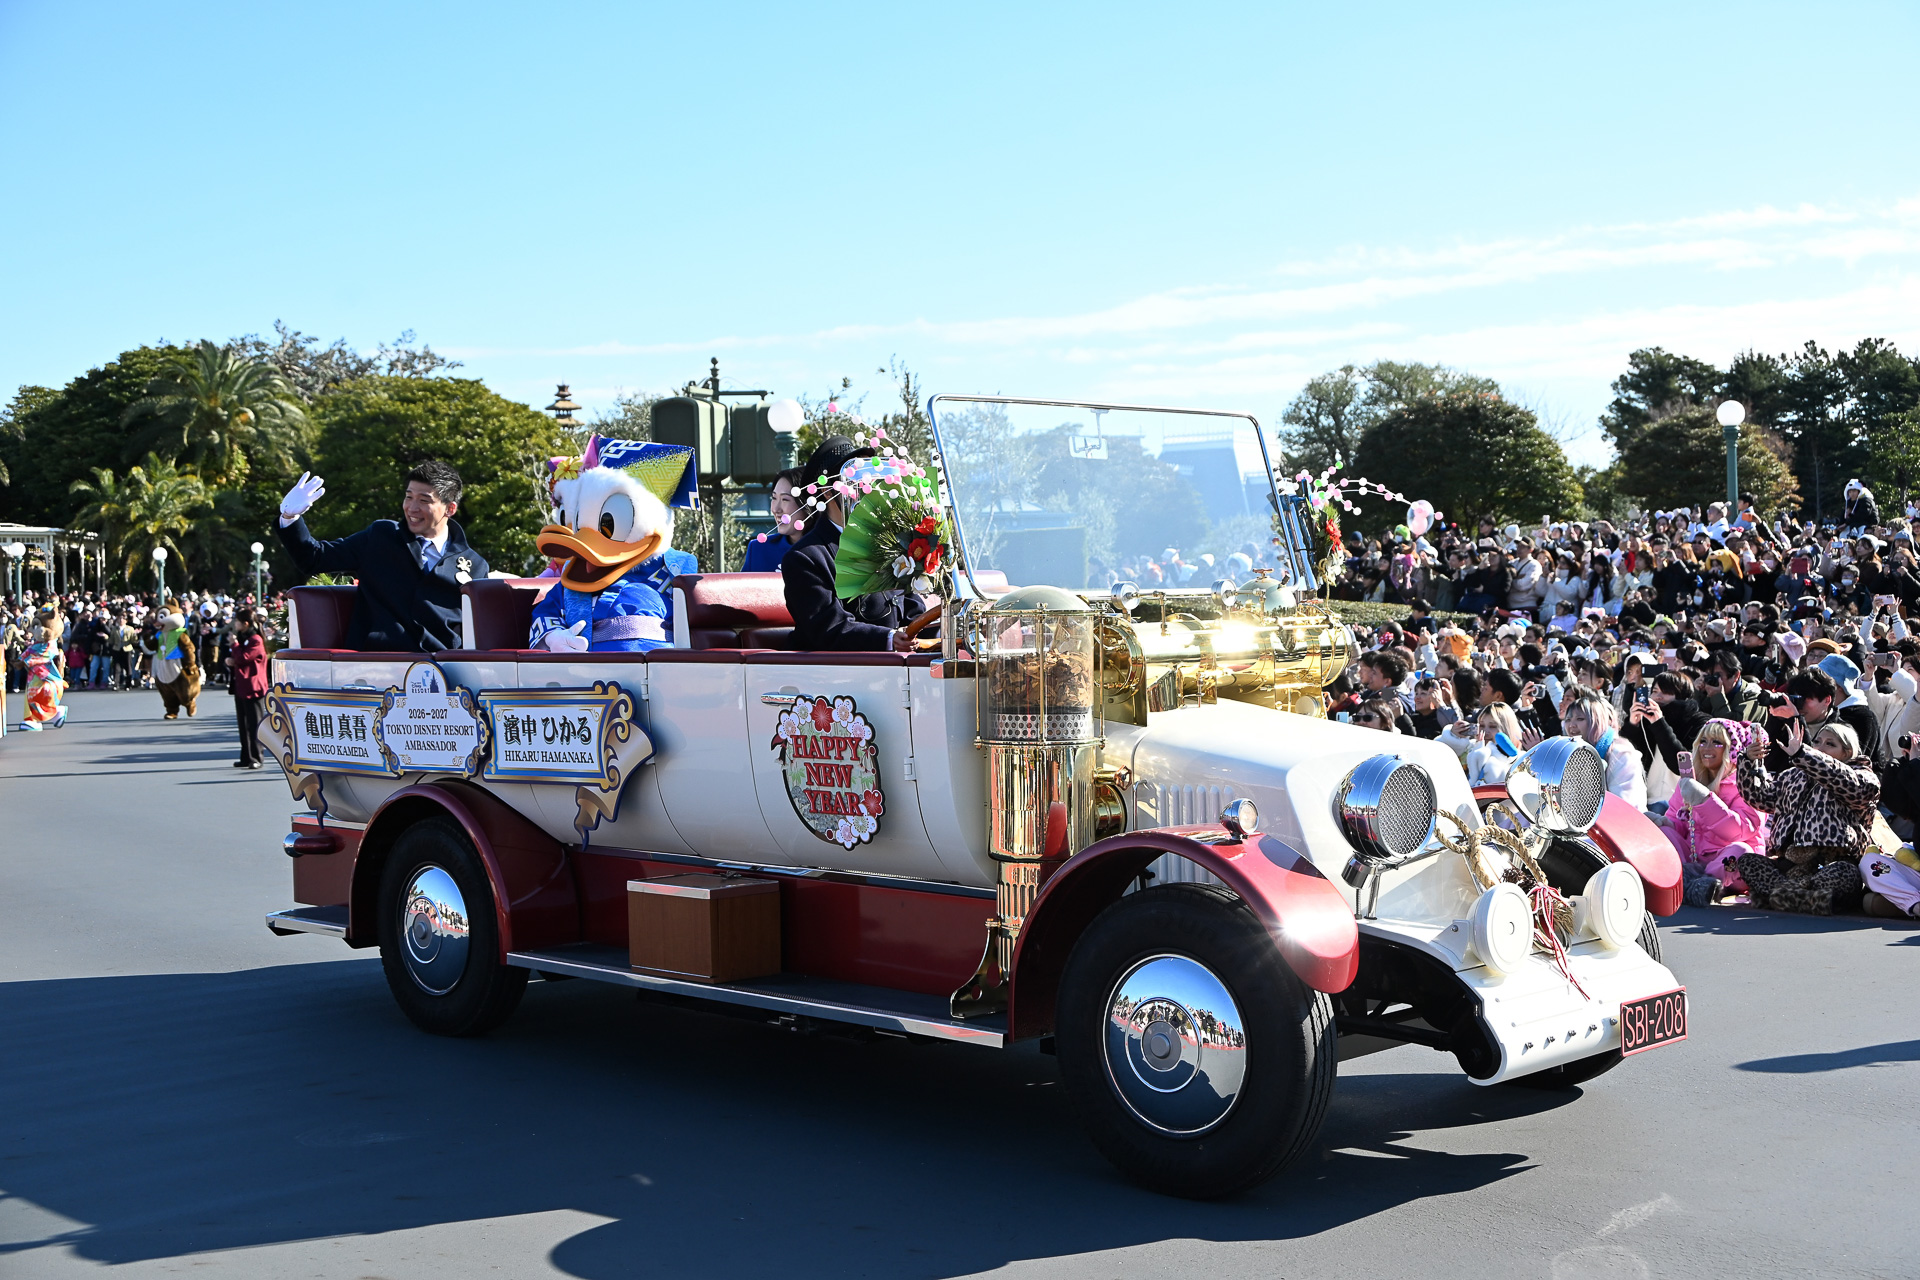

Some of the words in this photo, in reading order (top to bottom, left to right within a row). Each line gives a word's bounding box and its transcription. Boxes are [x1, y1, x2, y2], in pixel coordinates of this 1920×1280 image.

[304, 710, 334, 739] 亀田
[337, 713, 367, 742] 真吾
[408, 708, 448, 719] 2026-2027
[385, 724, 412, 735] TOKYO
[413, 724, 442, 735] DISNEY
[443, 724, 475, 736] RESORT
[503, 714, 537, 746] 濱中
[541, 715, 592, 746] ひかる
[307, 743, 336, 756] SHINGO
[336, 745, 370, 758] KAMEDA
[404, 740, 458, 752] AMBASSADOR
[504, 750, 540, 762] HIKARU
[540, 751, 595, 764] HAMANAKA
[790, 735, 863, 761] HAPPY
[803, 762, 854, 788] NEW
[803, 789, 865, 816] YEAR
[1625, 994, 1684, 1048] SBI-208
